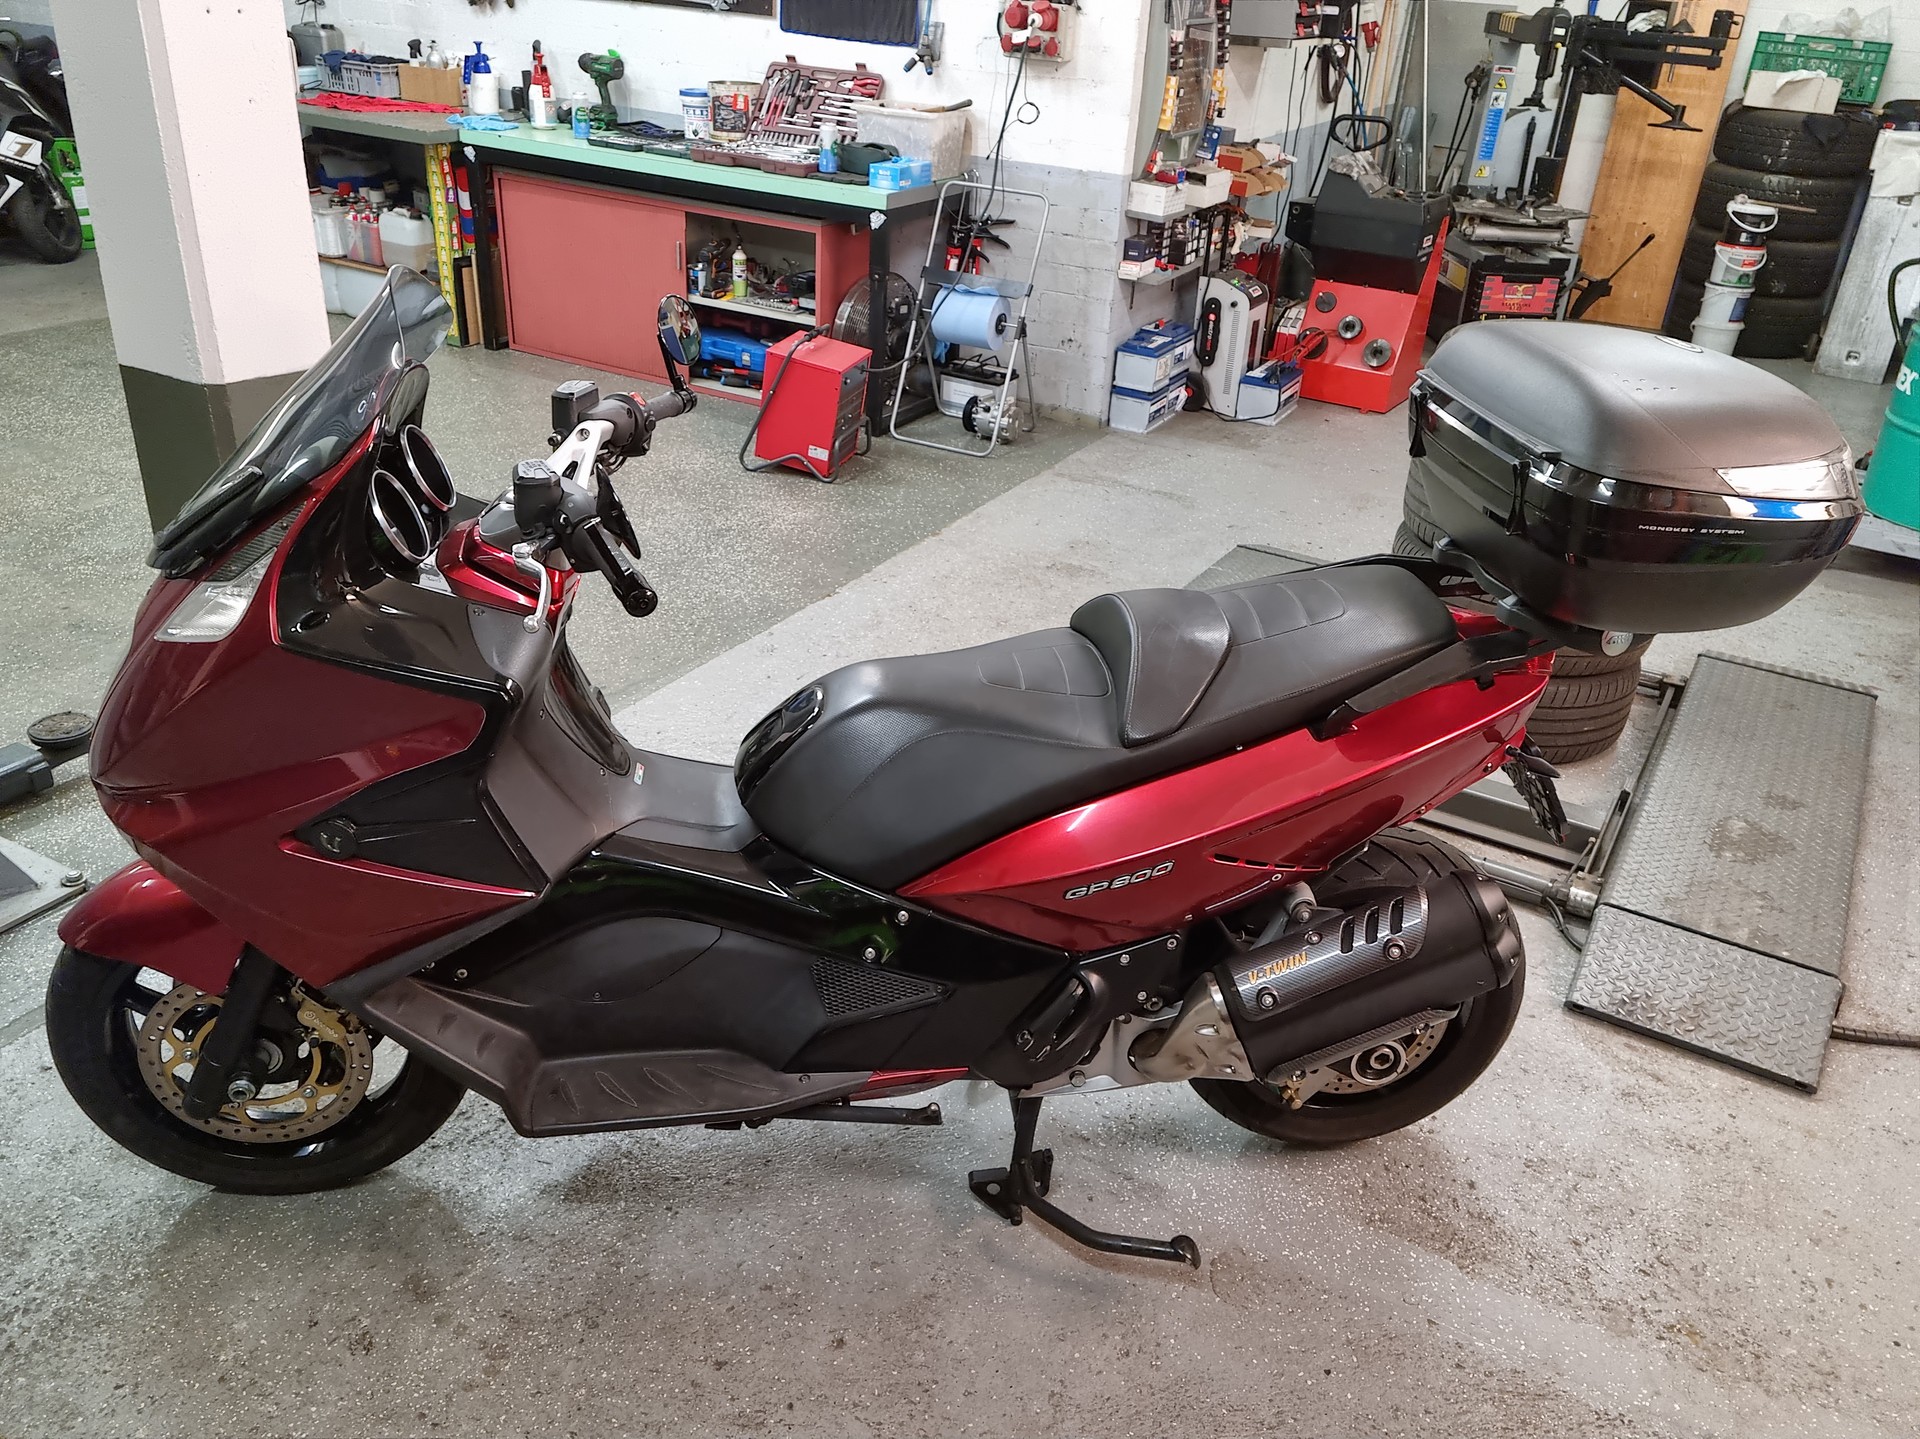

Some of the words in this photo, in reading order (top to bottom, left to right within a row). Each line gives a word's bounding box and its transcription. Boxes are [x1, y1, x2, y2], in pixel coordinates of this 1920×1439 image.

[1638, 524, 1695, 533] MONOKEY
[1064, 860, 1175, 900] GP800
[1248, 951, 1308, 985] V-TWIN
